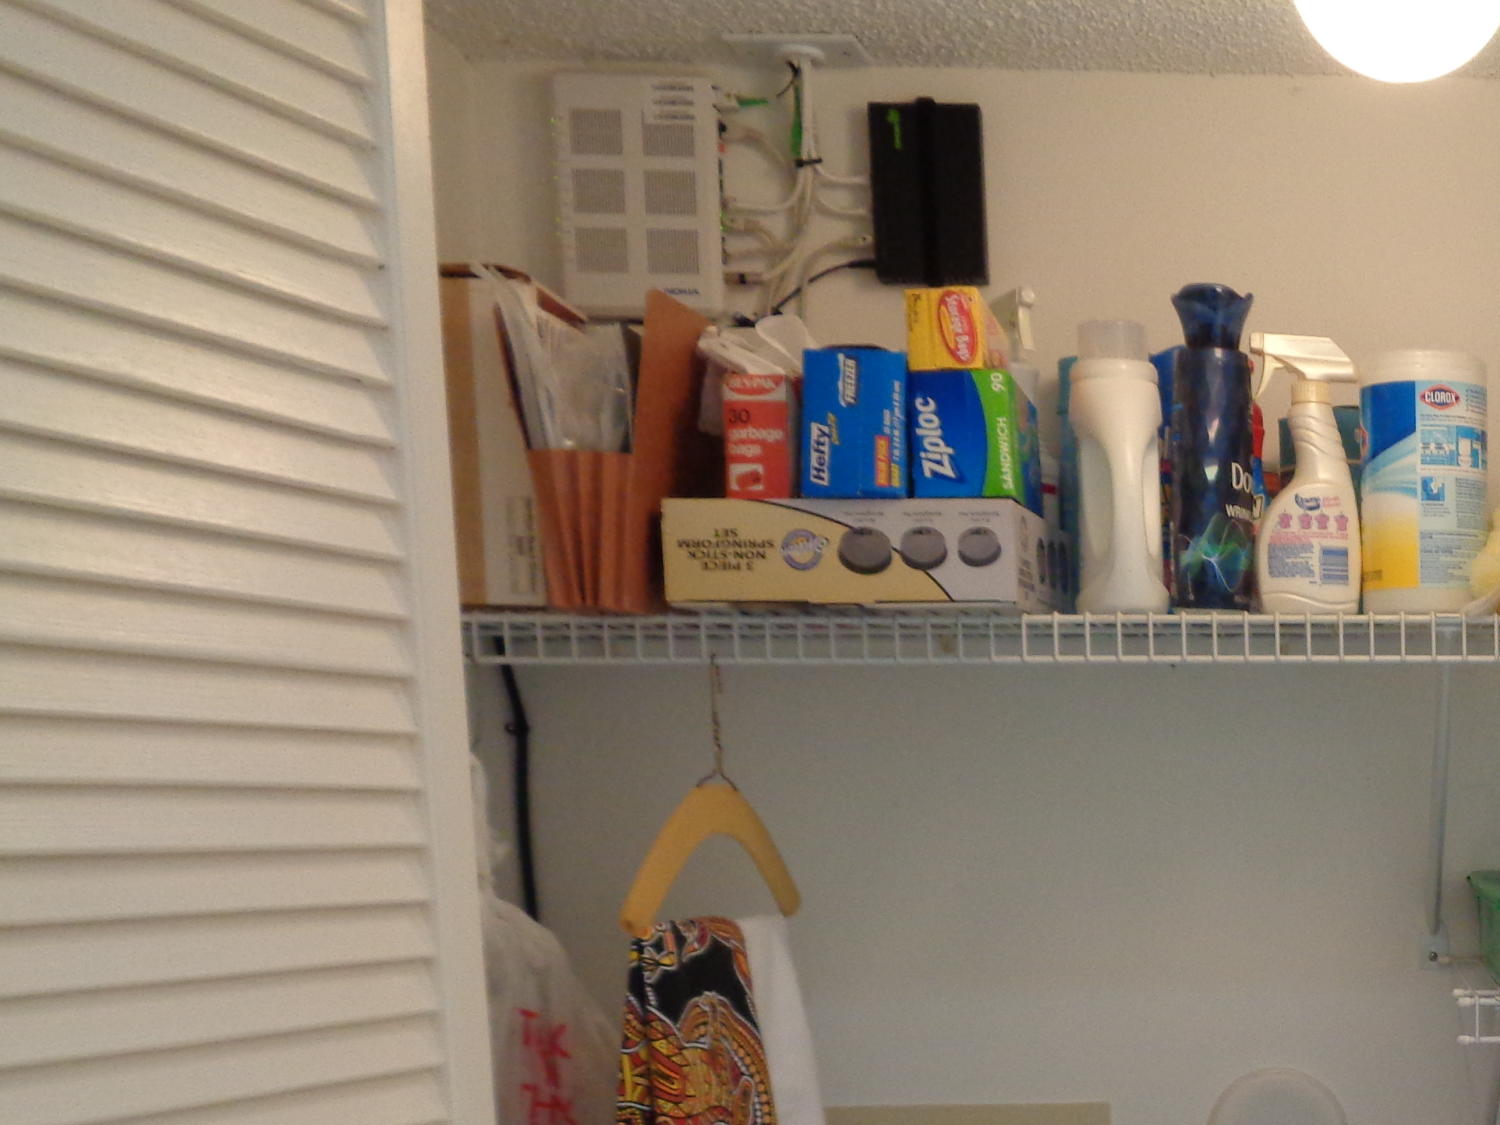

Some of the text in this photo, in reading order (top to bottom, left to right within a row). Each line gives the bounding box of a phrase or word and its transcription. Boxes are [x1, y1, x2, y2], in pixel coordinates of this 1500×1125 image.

[842, 357, 857, 403] FREEZER
[990, 372, 1005, 391] 90
[1423, 390, 1458, 403] CLOROX
[728, 409, 750, 424] 30
[915, 397, 956, 480] Ziploc
[811, 425, 831, 485] Hefty
[996, 416, 1014, 490] SANDWICH
[714, 528, 738, 538] SET
[677, 538, 774, 550] SPRINGFORM
[687, 551, 767, 561] NON-STICK
